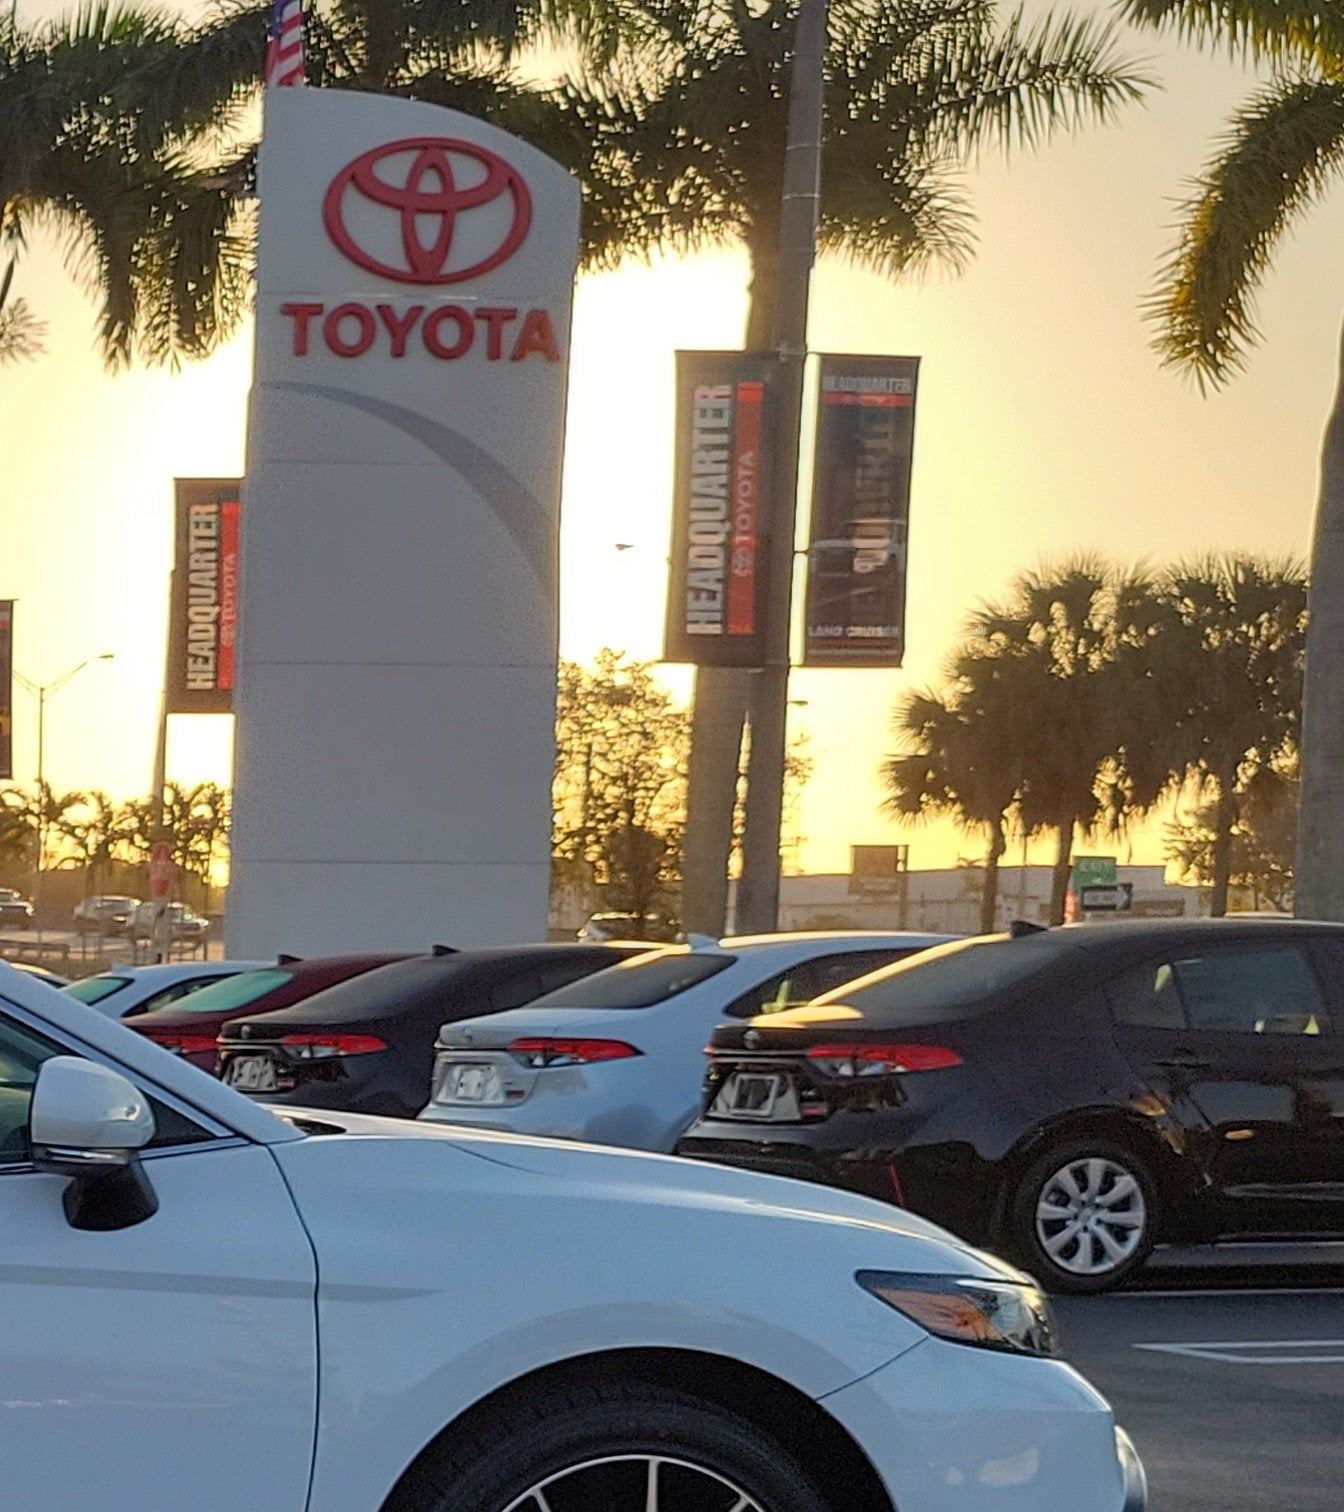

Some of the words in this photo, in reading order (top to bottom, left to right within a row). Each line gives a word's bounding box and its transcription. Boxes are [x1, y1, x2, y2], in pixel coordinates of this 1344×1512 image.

[280, 302, 560, 362] TOYOTA
[686, 384, 733, 635] HEADQUARTER
[733, 451, 755, 546] TOYOTA
[186, 504, 221, 689] HEADQUARTER
